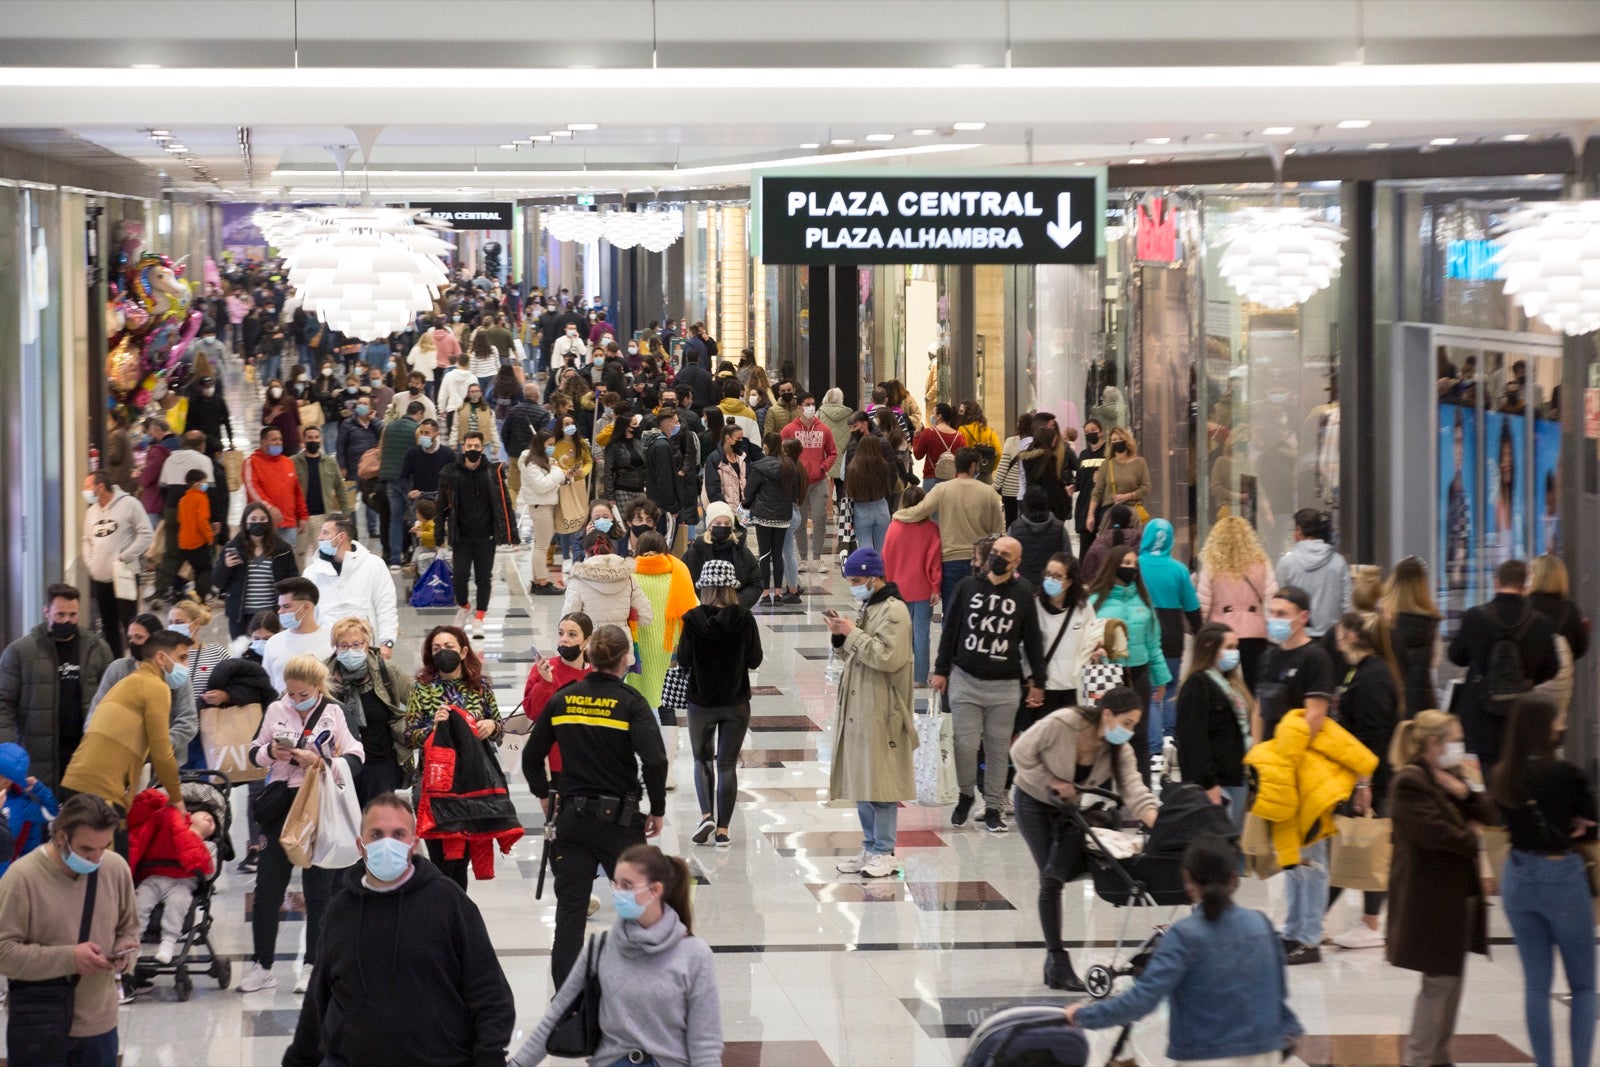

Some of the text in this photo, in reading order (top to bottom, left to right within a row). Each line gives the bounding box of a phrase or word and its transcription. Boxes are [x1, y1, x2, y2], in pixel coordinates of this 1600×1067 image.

[787, 191, 1043, 216] PLAZA CENTRAL
[454, 212, 502, 220] CENTRAL
[805, 227, 1024, 249] PLAZA ALHAMBRA
[968, 592, 1016, 615] STO
[967, 612, 1013, 634] CKH
[964, 633, 1009, 656] OLM
[564, 695, 619, 709] VIGILANT
[566, 706, 612, 717] SEGURIDAD
